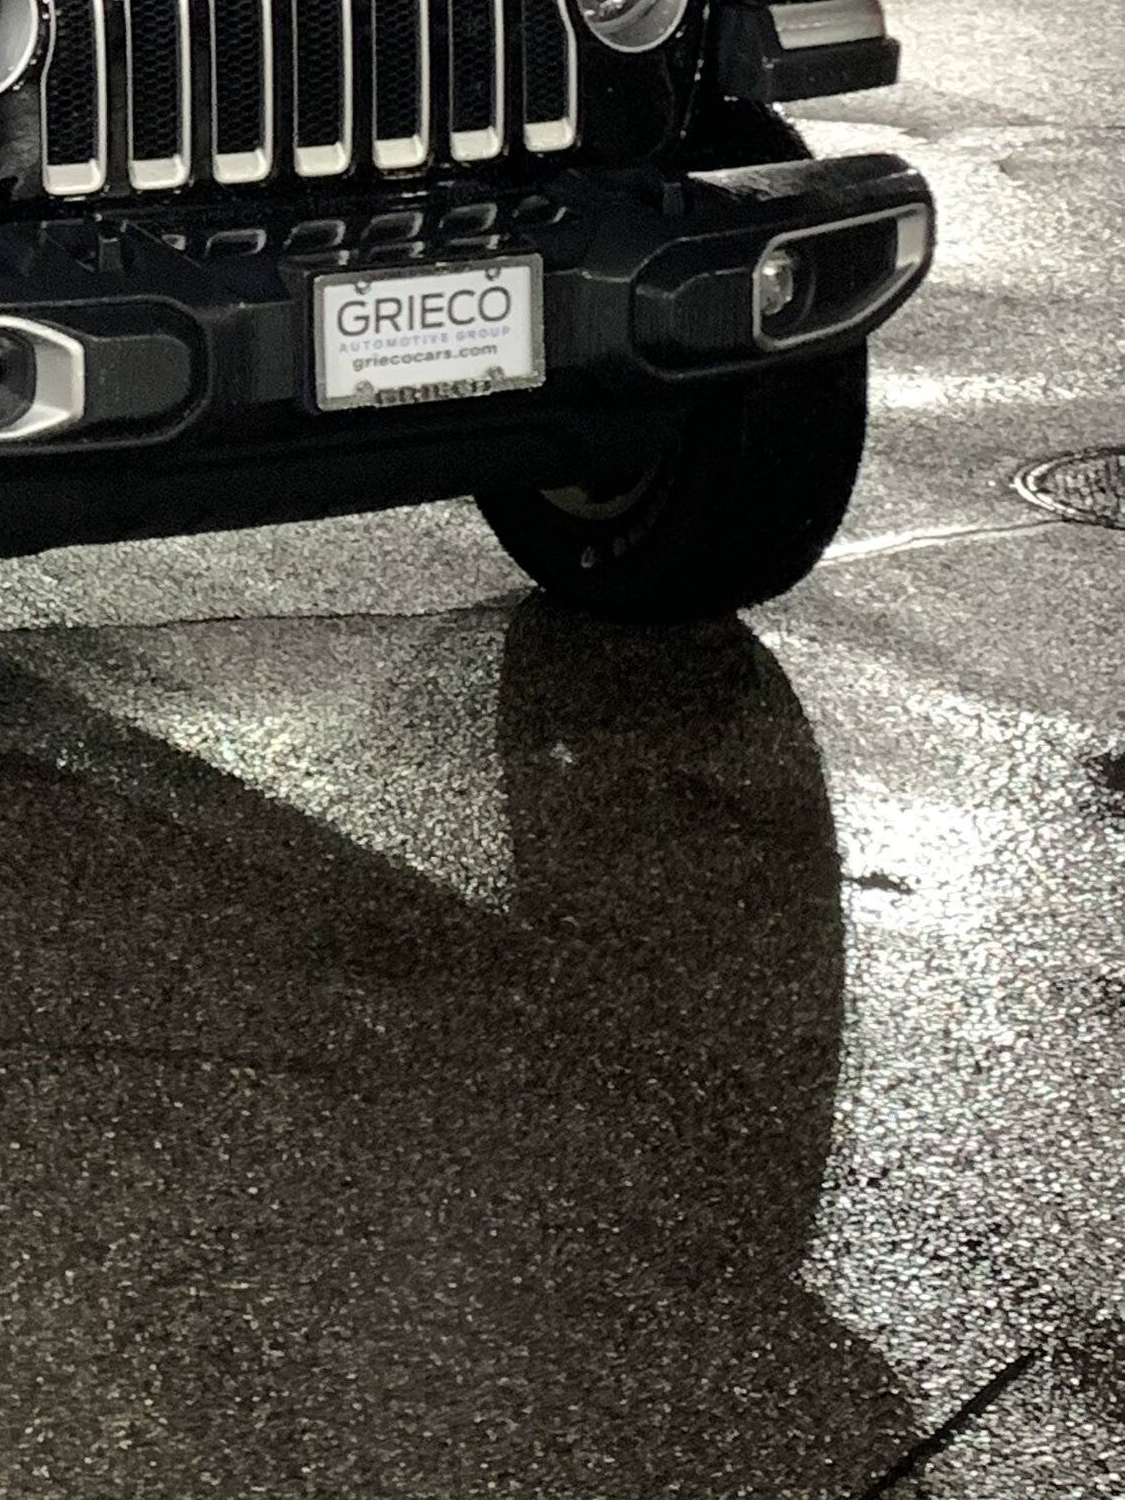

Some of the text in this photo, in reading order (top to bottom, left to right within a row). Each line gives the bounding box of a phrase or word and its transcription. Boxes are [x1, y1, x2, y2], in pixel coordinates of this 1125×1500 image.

[337, 286, 512, 337] GRIECO
[339, 326, 512, 353] AUTOMOTIVE GROUP
[352, 344, 499, 372] griecocars.com
